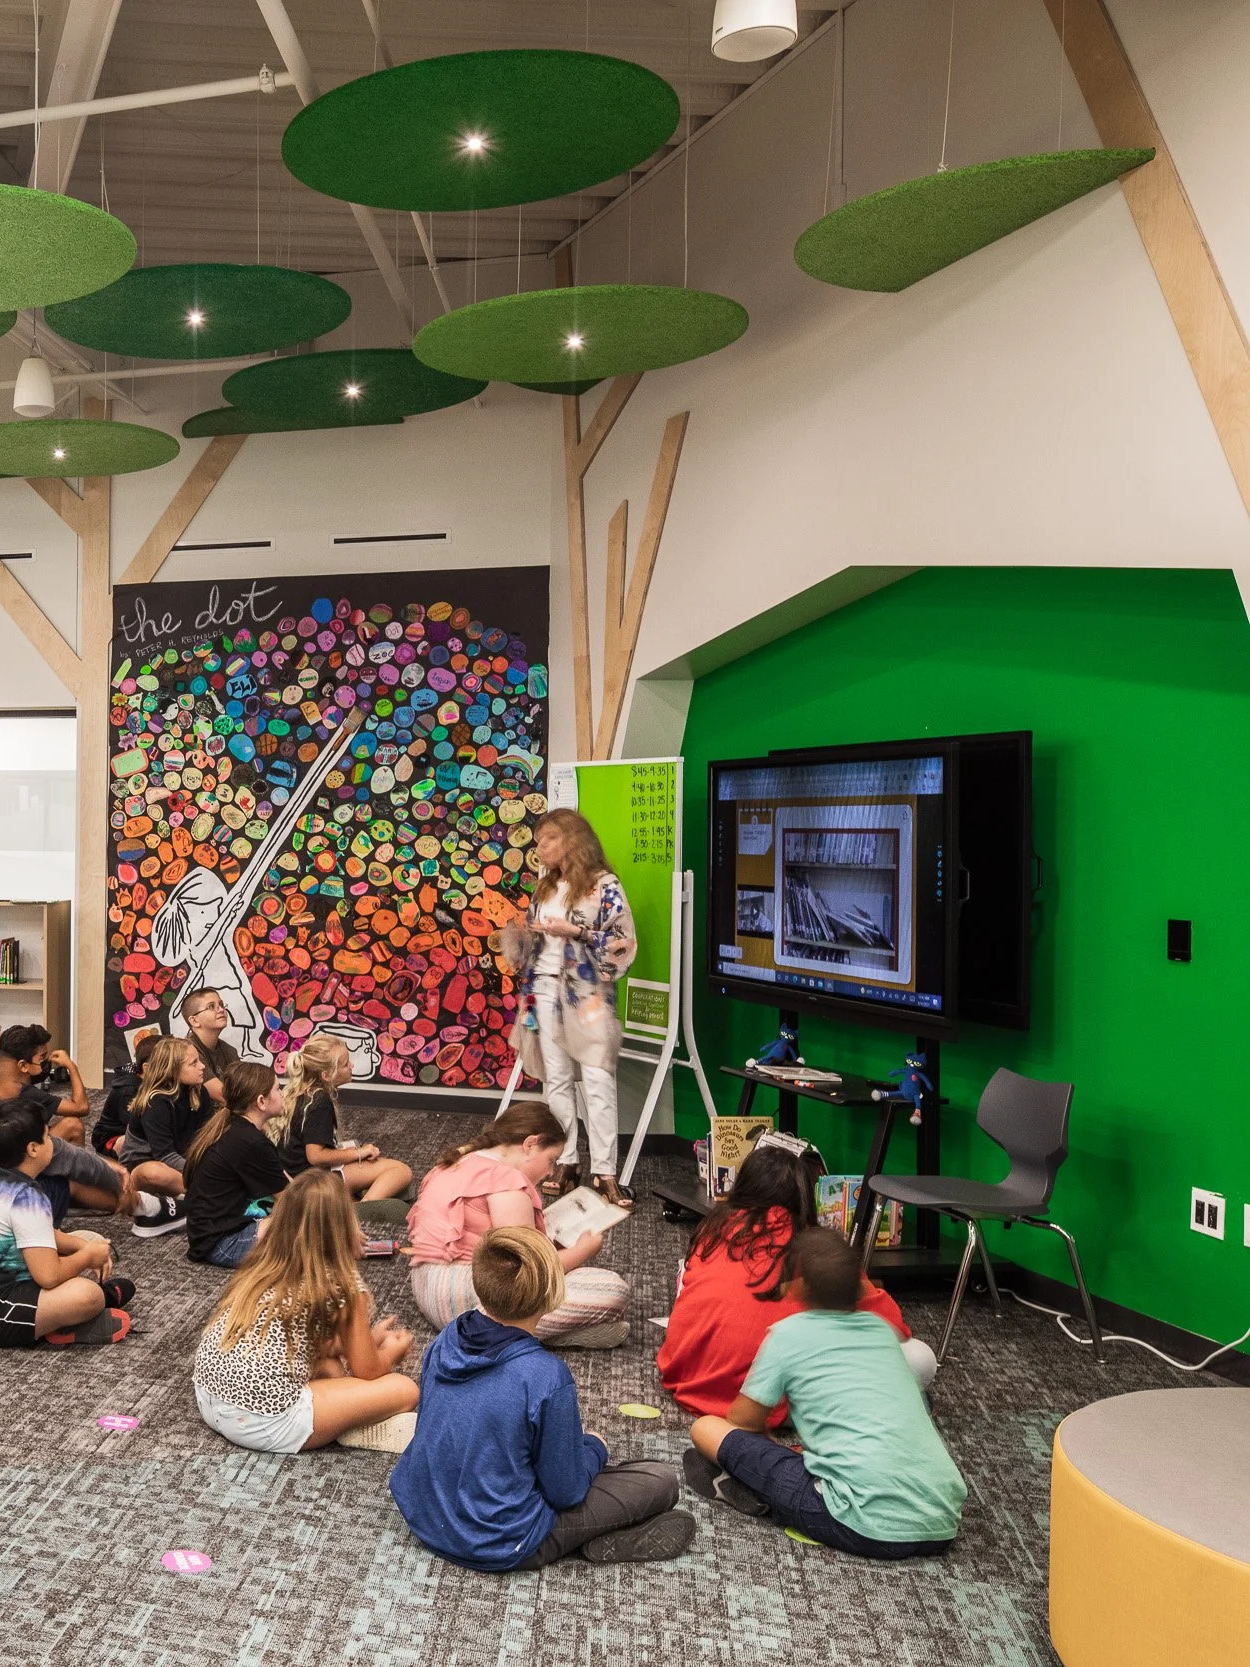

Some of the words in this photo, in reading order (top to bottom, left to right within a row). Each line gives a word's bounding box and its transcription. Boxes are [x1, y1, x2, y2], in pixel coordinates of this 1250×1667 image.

[118, 597, 182, 643] the
[195, 581, 283, 630] dot
[135, 643, 163, 658] PETER
[181, 630, 224, 645] REYNOLDS
[733, 1124, 741, 1132] Do
[716, 1131, 744, 1142] Dinosaurs
[724, 1137, 734, 1145] Say
[721, 1143, 738, 1151] Good
